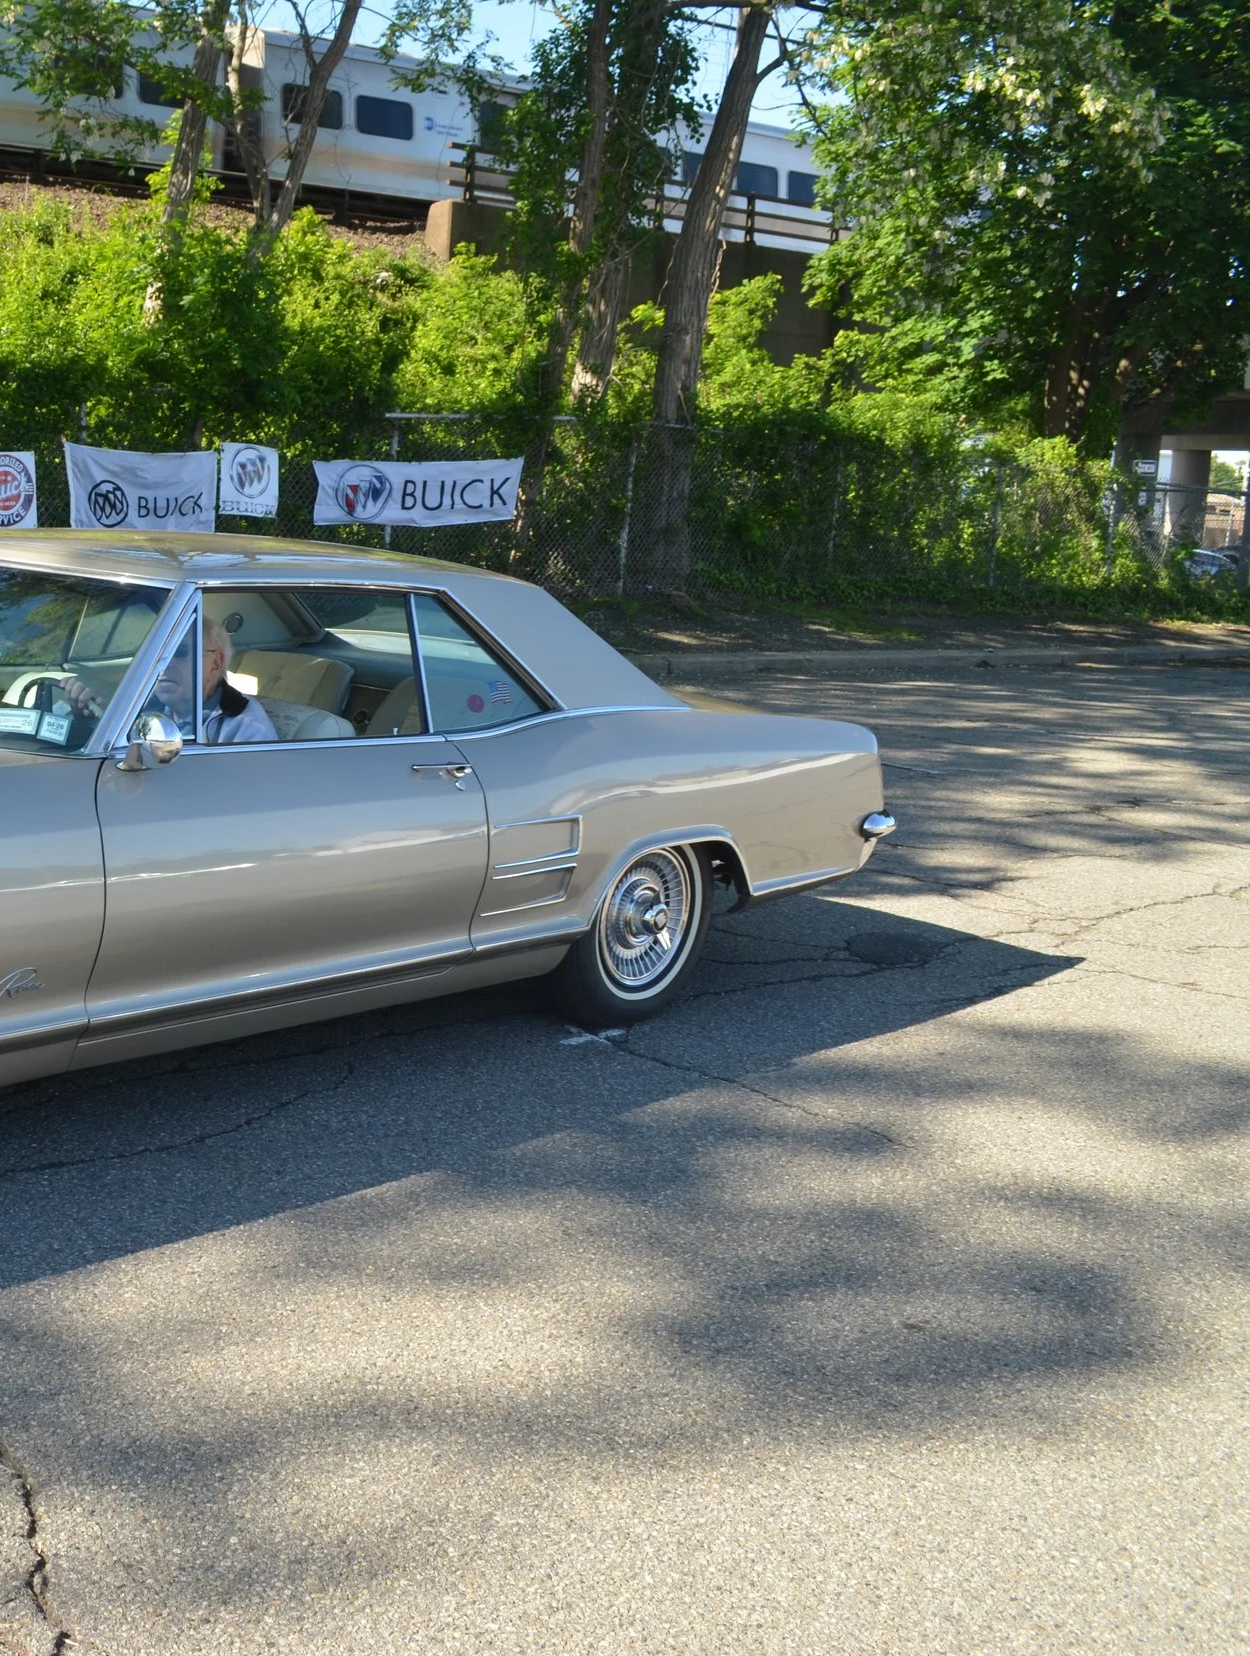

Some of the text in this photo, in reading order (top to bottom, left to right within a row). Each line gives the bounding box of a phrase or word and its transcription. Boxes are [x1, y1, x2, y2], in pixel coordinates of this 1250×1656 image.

[137, 491, 204, 519] BUICK
[219, 500, 276, 517] BUICK
[401, 477, 512, 512] BUICK
